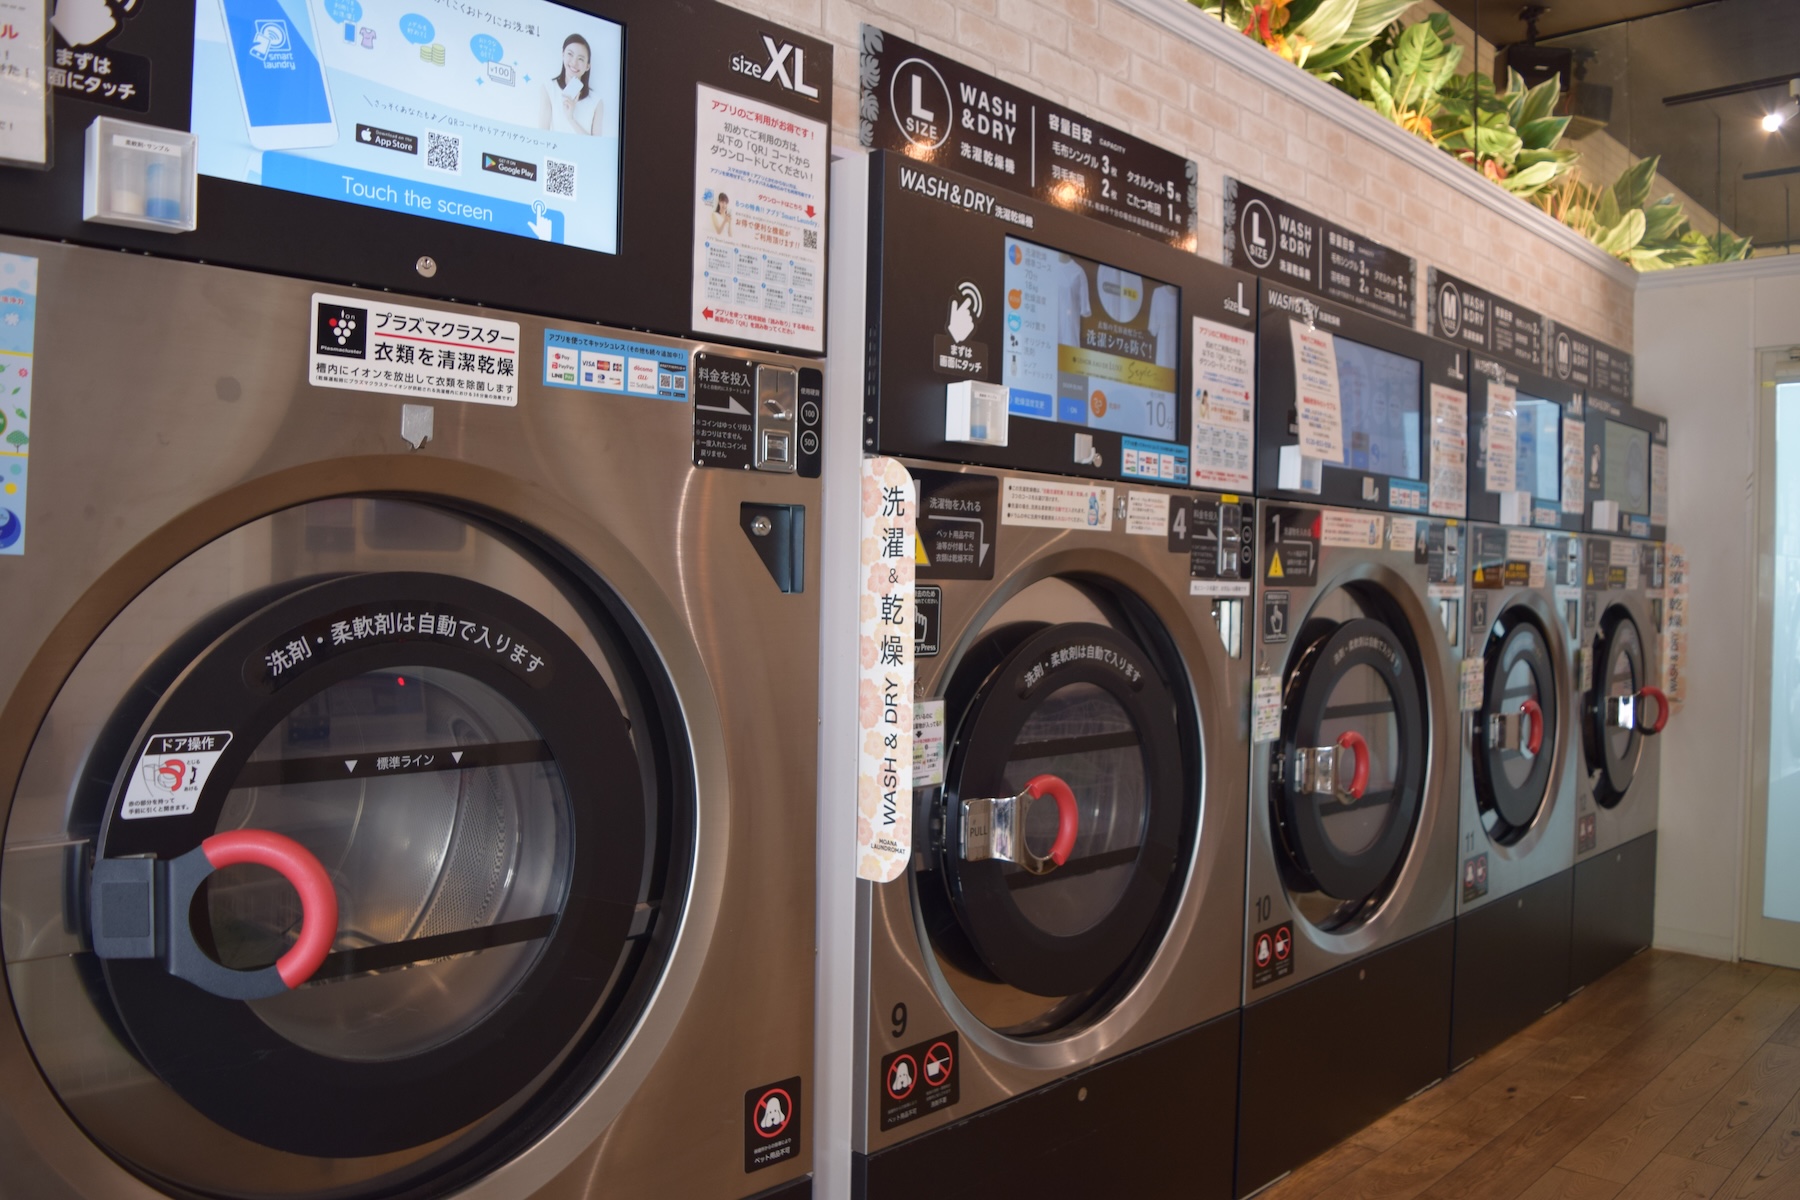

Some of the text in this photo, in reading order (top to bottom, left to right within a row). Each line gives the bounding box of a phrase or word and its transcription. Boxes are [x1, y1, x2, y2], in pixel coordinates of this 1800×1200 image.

[56, 48, 111, 75] まずは
[263, 60, 296, 71] laundry
[268, 53, 294, 62] smart
[732, 35, 819, 99] size XL
[911, 73, 935, 123] L
[959, 82, 1018, 123] WASH
[724, 122, 800, 154] 初めてご利用の方は、
[905, 117, 939, 141] SIZE
[961, 108, 1017, 146] &DRY
[1048, 113, 1093, 146] 容量目安
[375, 135, 413, 151] App Store
[716, 133, 811, 169] 以下の「QR」コードから
[1051, 140, 1100, 170] 毛布シングル
[710, 145, 814, 182] ダウンロードしてください!
[960, 141, 1016, 175] 洗濯乾燥機
[498, 163, 534, 179] Google Play
[1126, 170, 1166, 196] タオルケット
[342, 176, 493, 222] Touch the screen
[1125, 193, 1162, 218] こたつ布団
[994, 204, 1034, 229] 洗濯乾燥機
[1278, 213, 1312, 242] WASH
[1252, 211, 1267, 248] L
[1249, 244, 1268, 261] SIZE
[1224, 282, 1251, 317] size L
[1443, 291, 1457, 321] M
[1462, 292, 1485, 313] WASH
[375, 311, 516, 344] プラズマクラスター
[320, 345, 363, 355] Plasmacluster
[950, 344, 973, 359] まずは
[1086, 329, 1153, 359] 洗濯シワを防ぐ!
[374, 341, 515, 378] 衣類を清潔乾燥
[582, 360, 596, 368] VISA
[939, 354, 983, 374] 画面にタッチ
[316, 362, 514, 395] 槽内にイオンを放出して衣類を除菌します
[698, 367, 751, 388] 料金を投入
[701, 420, 753, 432] コインはゆっくり投入
[804, 409, 816, 418] 100
[701, 430, 743, 441] おつりはでません
[701, 440, 748, 451] 一度入れたコインは
[804, 438, 815, 447] 500
[700, 449, 728, 459] 戻りません
[929, 497, 982, 513] 洗濯物を入れる
[936, 529, 975, 541] ペット用品不可
[1172, 507, 1187, 540] 4
[1272, 514, 1281, 544] 1
[1417, 529, 1427, 556] 4
[265, 612, 545, 677] 洗剤・柔軟剤は自動で入ります
[920, 643, 937, 652] Press
[162, 736, 215, 753] ドア操作
[883, 677, 899, 826] WASH & DRY
[376, 754, 435, 771] 標準ライン
[128, 798, 175, 807] 赤の部分を持って
[878, 838, 898, 848] MOANA
[969, 825, 988, 838] PULL
[870, 842, 906, 856] LAUNDROMAT
[1255, 894, 1272, 924] 10
[891, 1002, 908, 1039] 9
